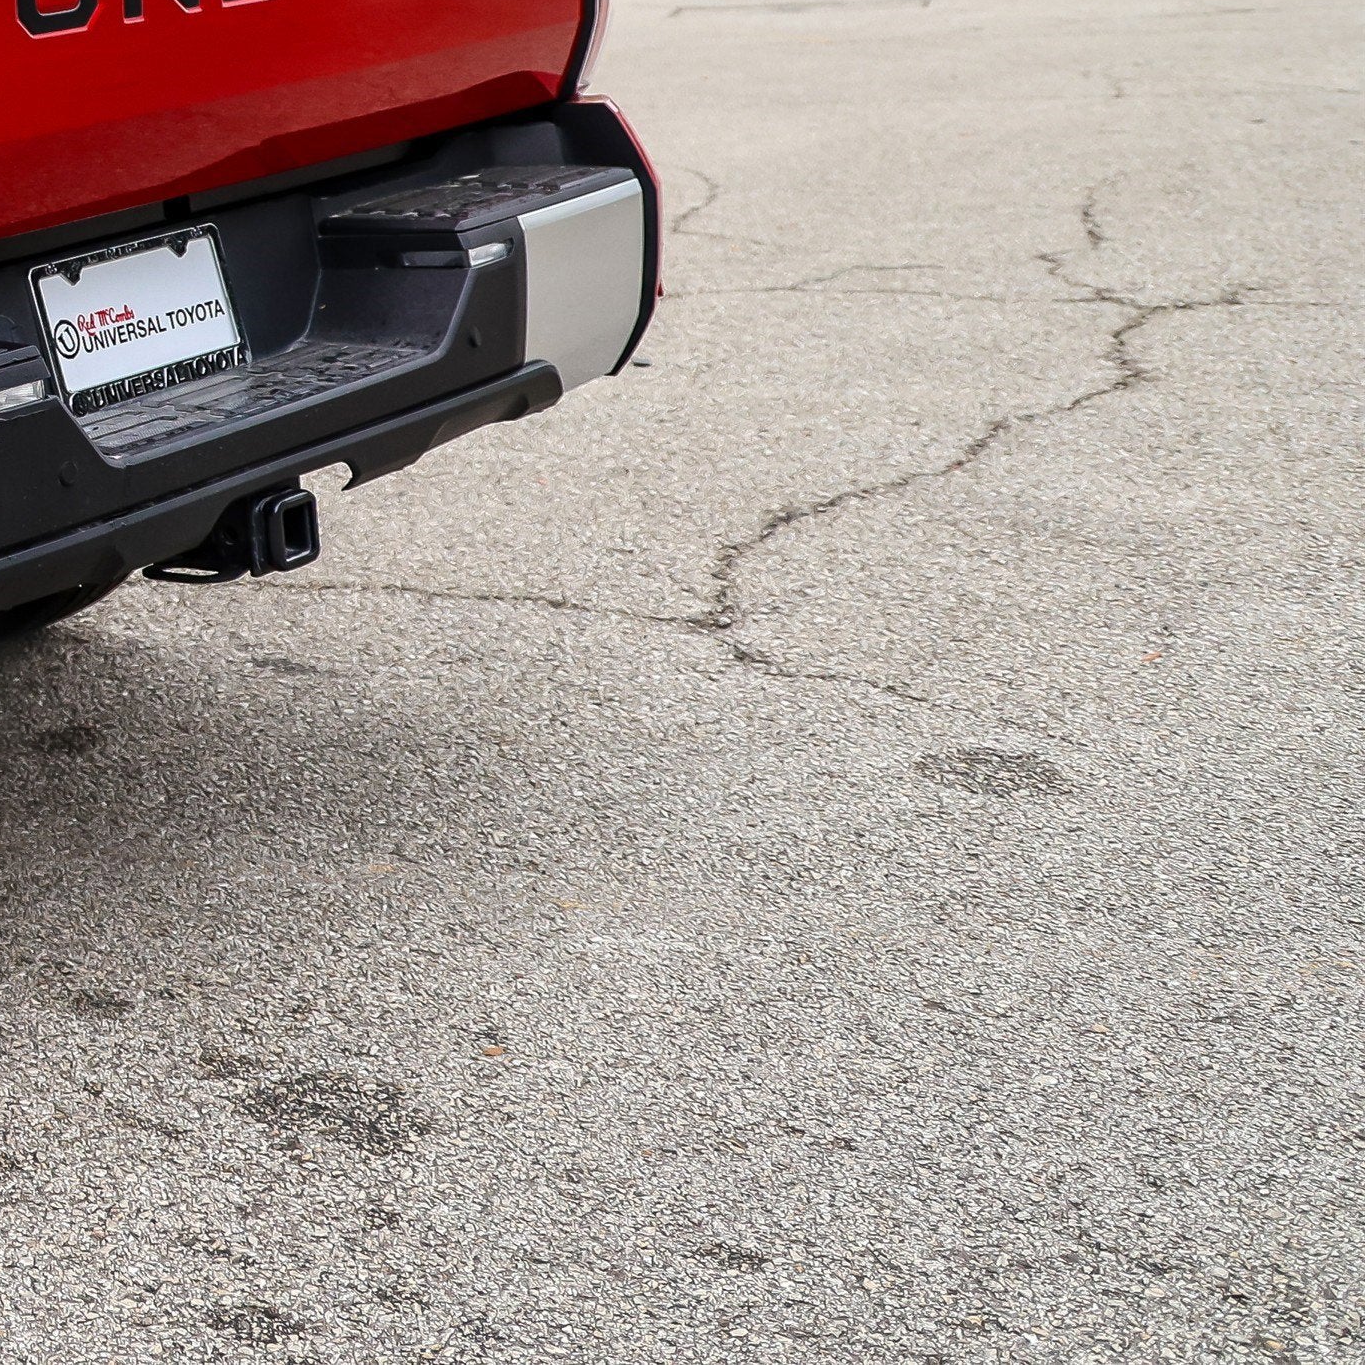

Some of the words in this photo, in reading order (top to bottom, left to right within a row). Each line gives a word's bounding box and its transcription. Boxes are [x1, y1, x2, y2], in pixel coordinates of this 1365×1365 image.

[77, 313, 97, 336] Red
[82, 315, 168, 354] UNIVERSAL
[167, 299, 226, 330] TOYOTA
[91, 368, 186, 409] UNIVERSAL
[187, 346, 247, 378] TOYOTA
